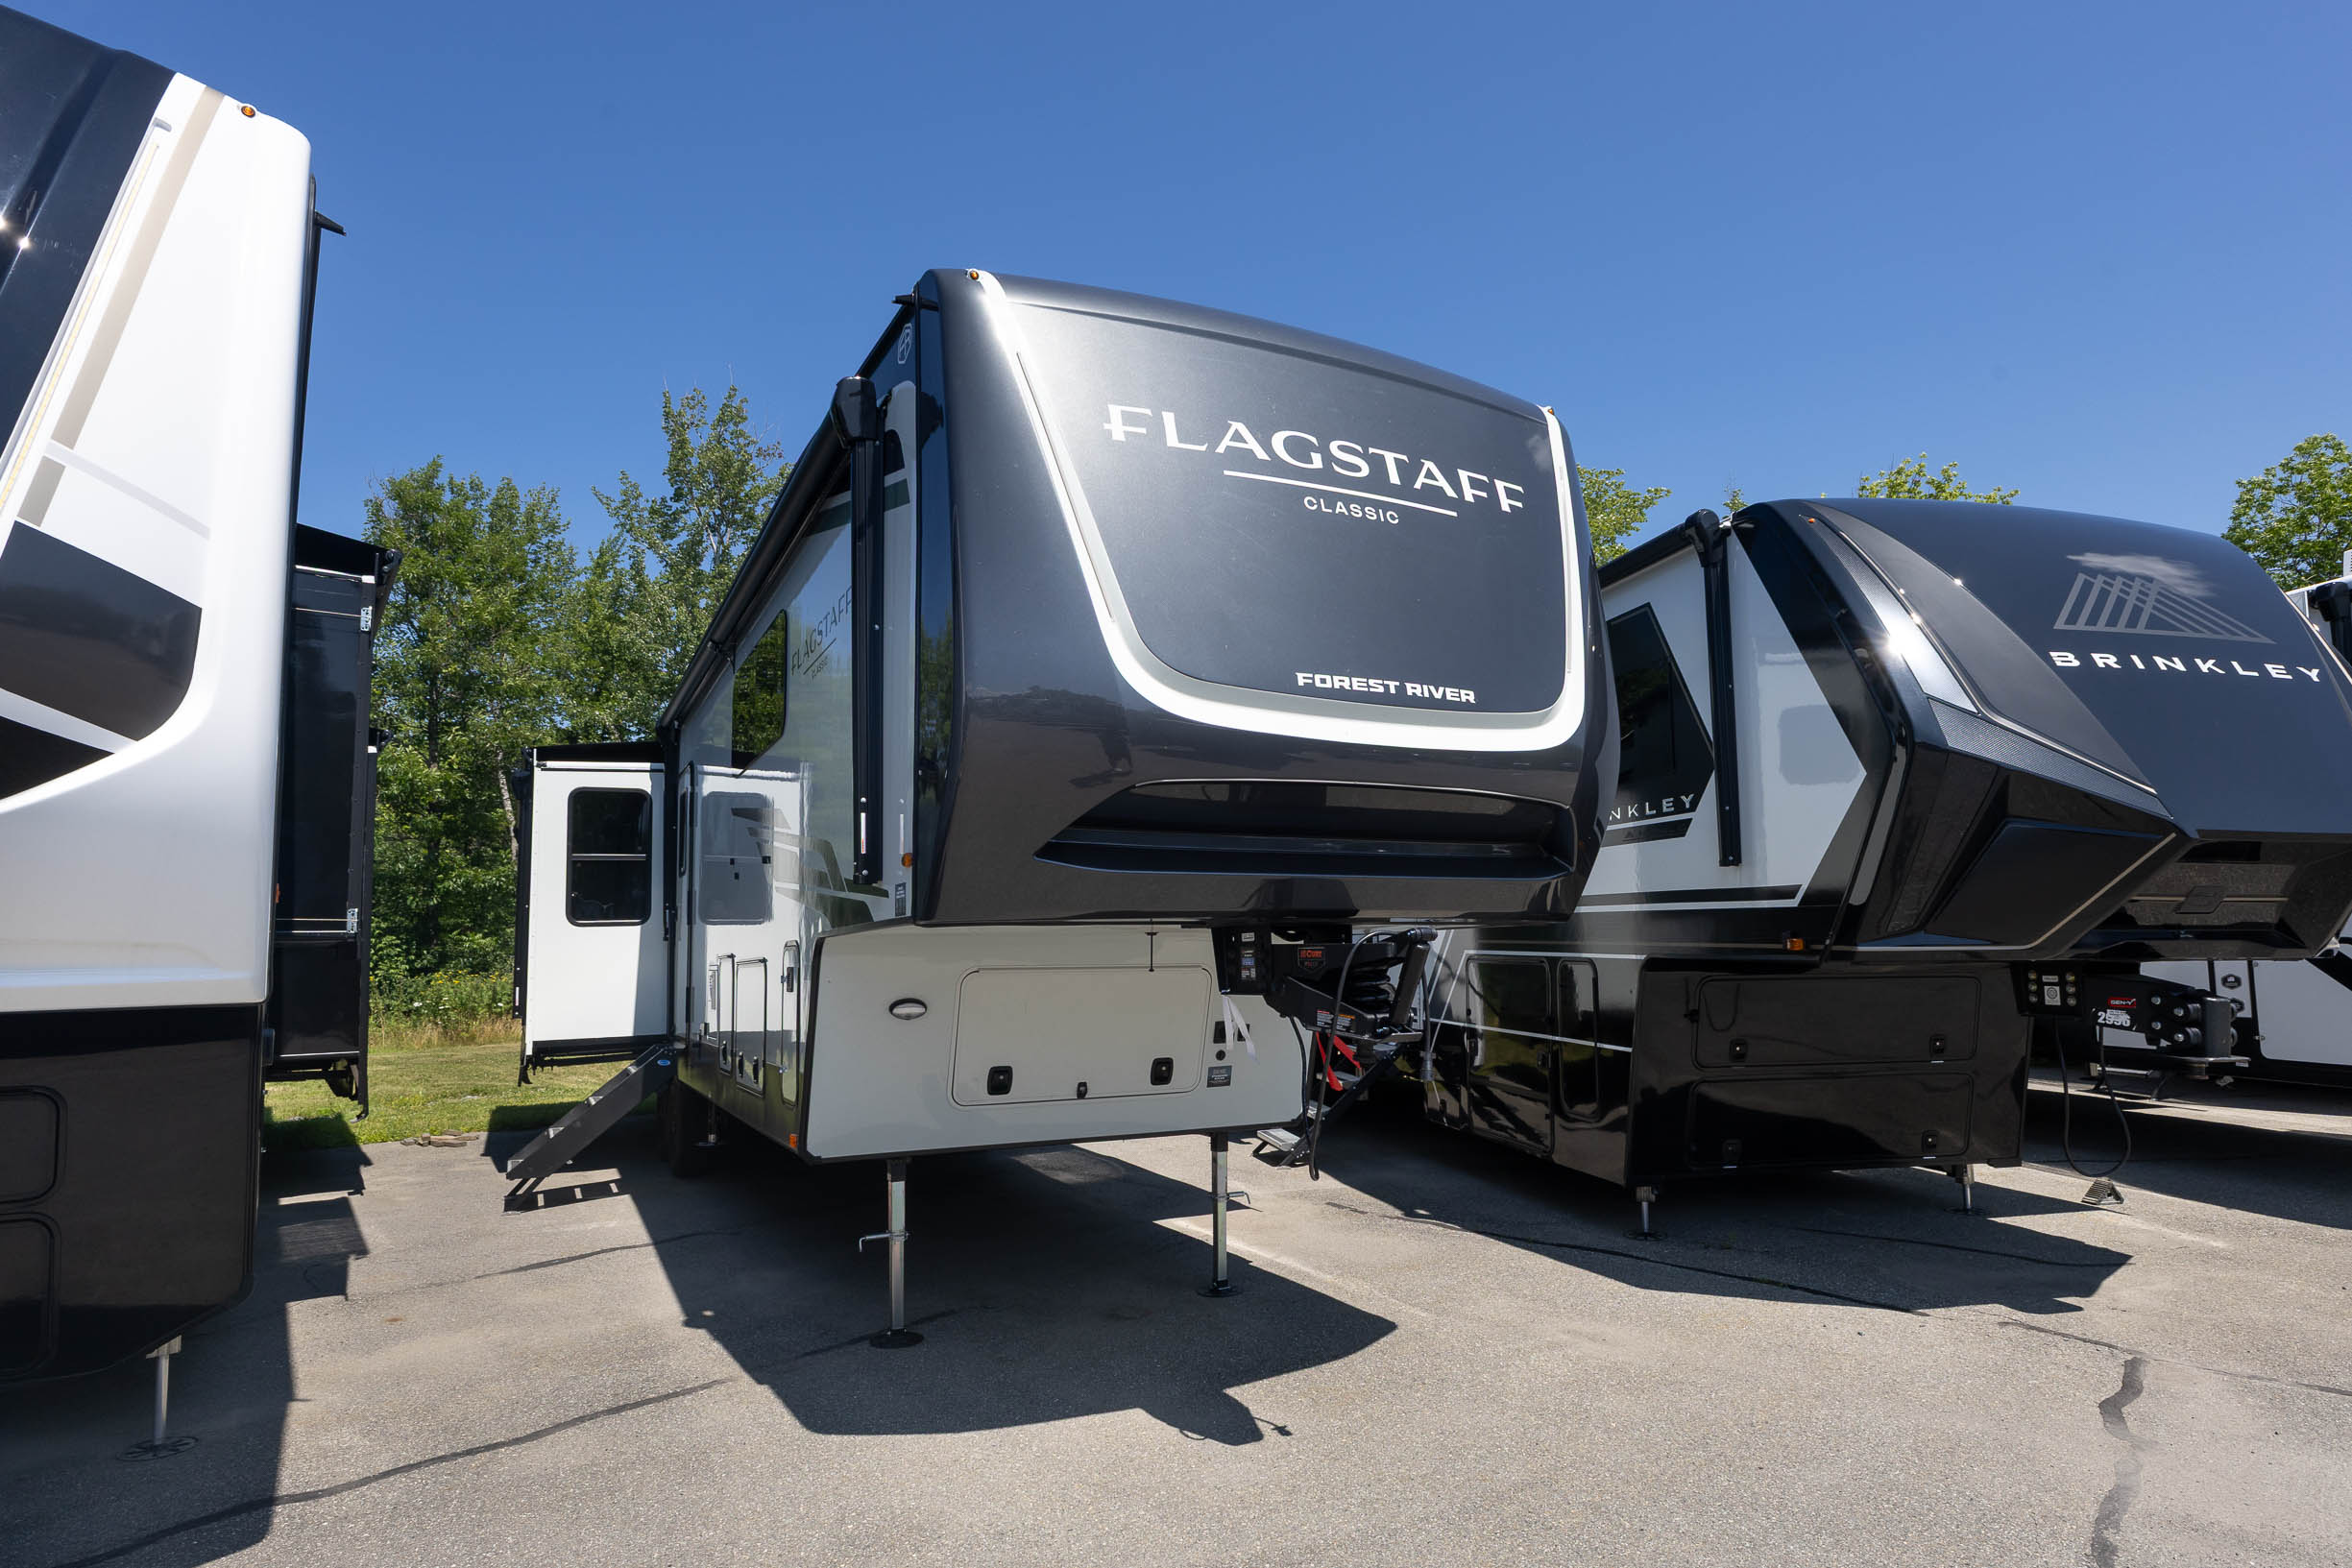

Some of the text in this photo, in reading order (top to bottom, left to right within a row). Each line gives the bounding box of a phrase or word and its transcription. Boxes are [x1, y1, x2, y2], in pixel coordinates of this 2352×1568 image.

[1103, 404, 1525, 514] FLAGSTAFF
[1303, 496, 1400, 524] CLASSIC
[2048, 651, 2321, 683] BRINKLEY
[1296, 672, 1476, 704] FOREST RIVER
